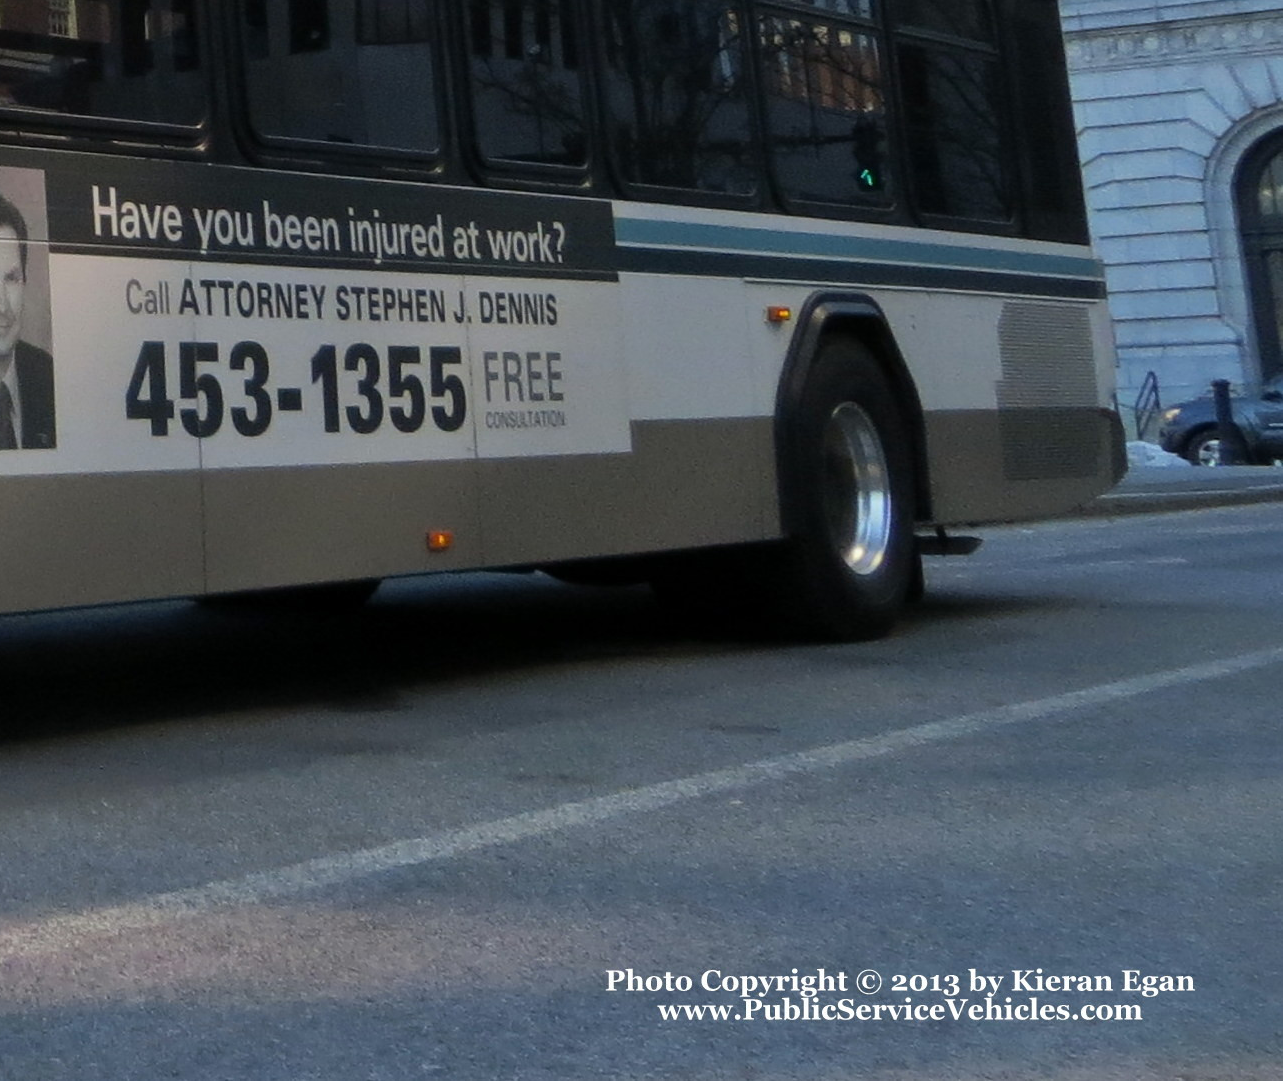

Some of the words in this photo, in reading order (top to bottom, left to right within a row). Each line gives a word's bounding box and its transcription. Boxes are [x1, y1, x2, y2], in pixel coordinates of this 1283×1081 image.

[92, 185, 183, 242] Have
[192, 208, 255, 255] you
[262, 200, 341, 251] been
[348, 207, 446, 264] injured
[453, 221, 482, 260] at
[486, 221, 566, 263] work?
[126, 278, 170, 315] Call
[179, 278, 326, 319] ATTORNEY
[336, 285, 446, 323] STEPHEN
[453, 290, 472, 324] J.
[479, 291, 558, 326] DENNIS
[125, 340, 468, 438] 453-1355
[482, 351, 564, 403] FREE
[485, 410, 567, 430] CONSULTATION
